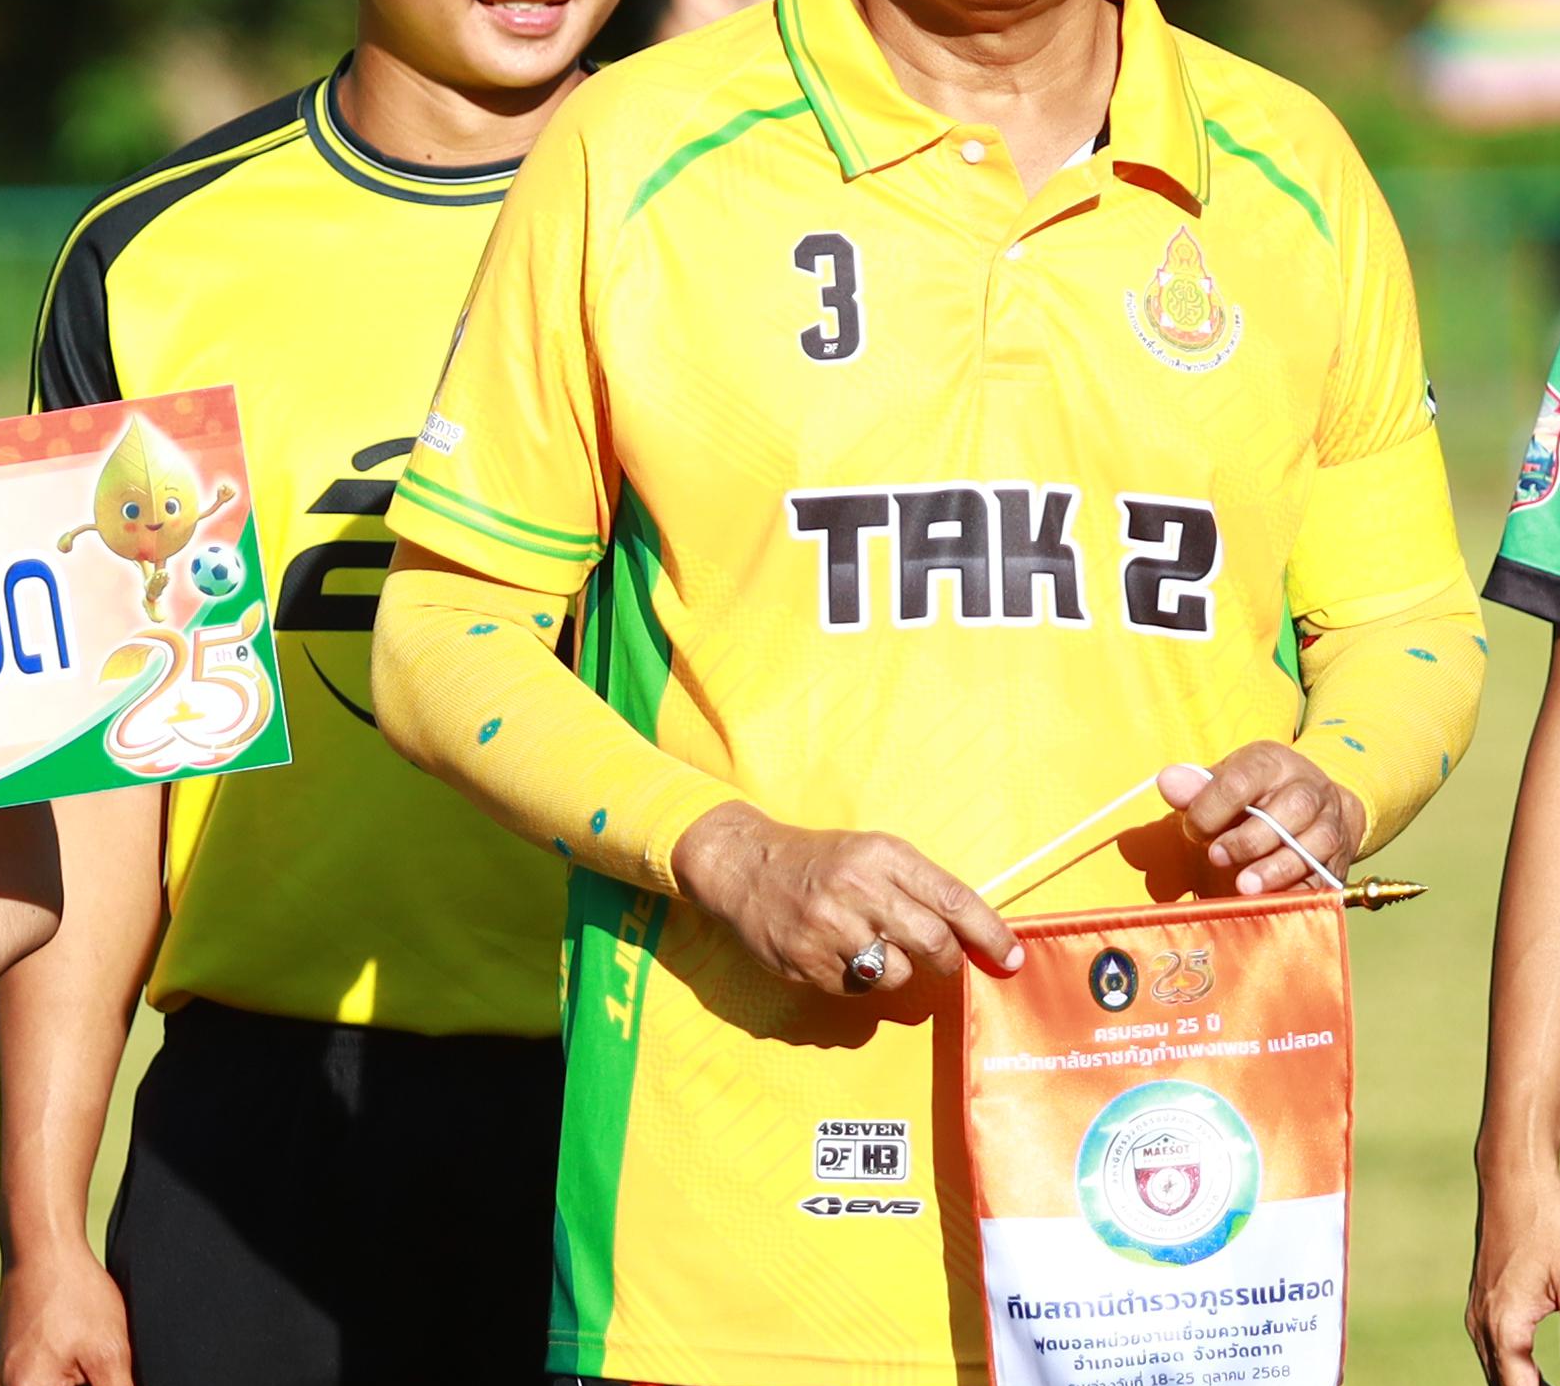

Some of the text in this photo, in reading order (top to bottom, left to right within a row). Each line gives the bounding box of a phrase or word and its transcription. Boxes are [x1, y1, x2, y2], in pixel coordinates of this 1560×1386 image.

[794, 233, 860, 360] 3
[791, 488, 1218, 633] TAK 2
[1094, 1013, 1222, 1043] ครบรอบ 25 ปี
[1268, 1030, 1334, 1054] แม่สอด
[818, 1121, 906, 1136] 4SEVEN
[820, 1147, 852, 1166] DF
[1007, 1277, 1335, 1321] ทีมสถานีตำรวจภูธรแม่สอด
[1074, 1342, 1283, 1371] อำเภอแม่สอด จังหวัดตาก
[1151, 1371, 1195, 1386] 18-25
[1202, 1369, 1246, 1386] ตุลาคม
[1252, 1364, 1291, 1380] 2568
